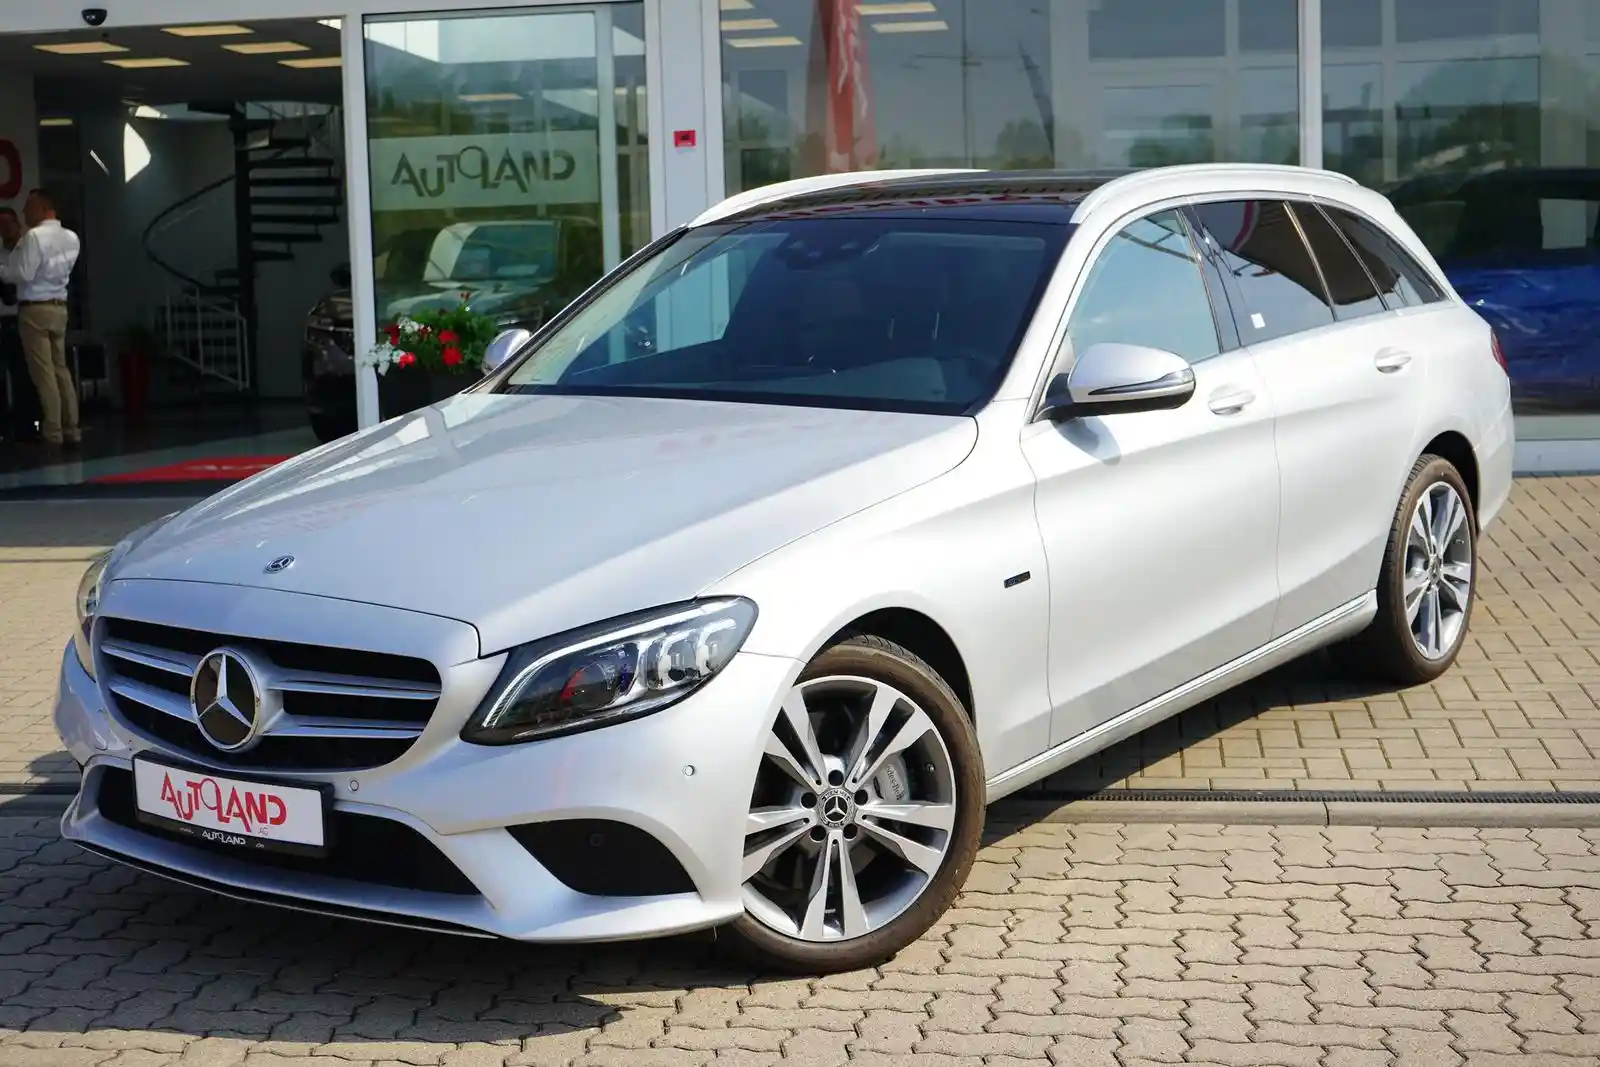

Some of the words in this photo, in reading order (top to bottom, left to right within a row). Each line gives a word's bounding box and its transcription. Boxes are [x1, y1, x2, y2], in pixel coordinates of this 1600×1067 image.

[390, 145, 576, 198] AUTOLAND
[160, 769, 288, 833] AUTOLAND
[201, 829, 246, 846] AUTOLAND
